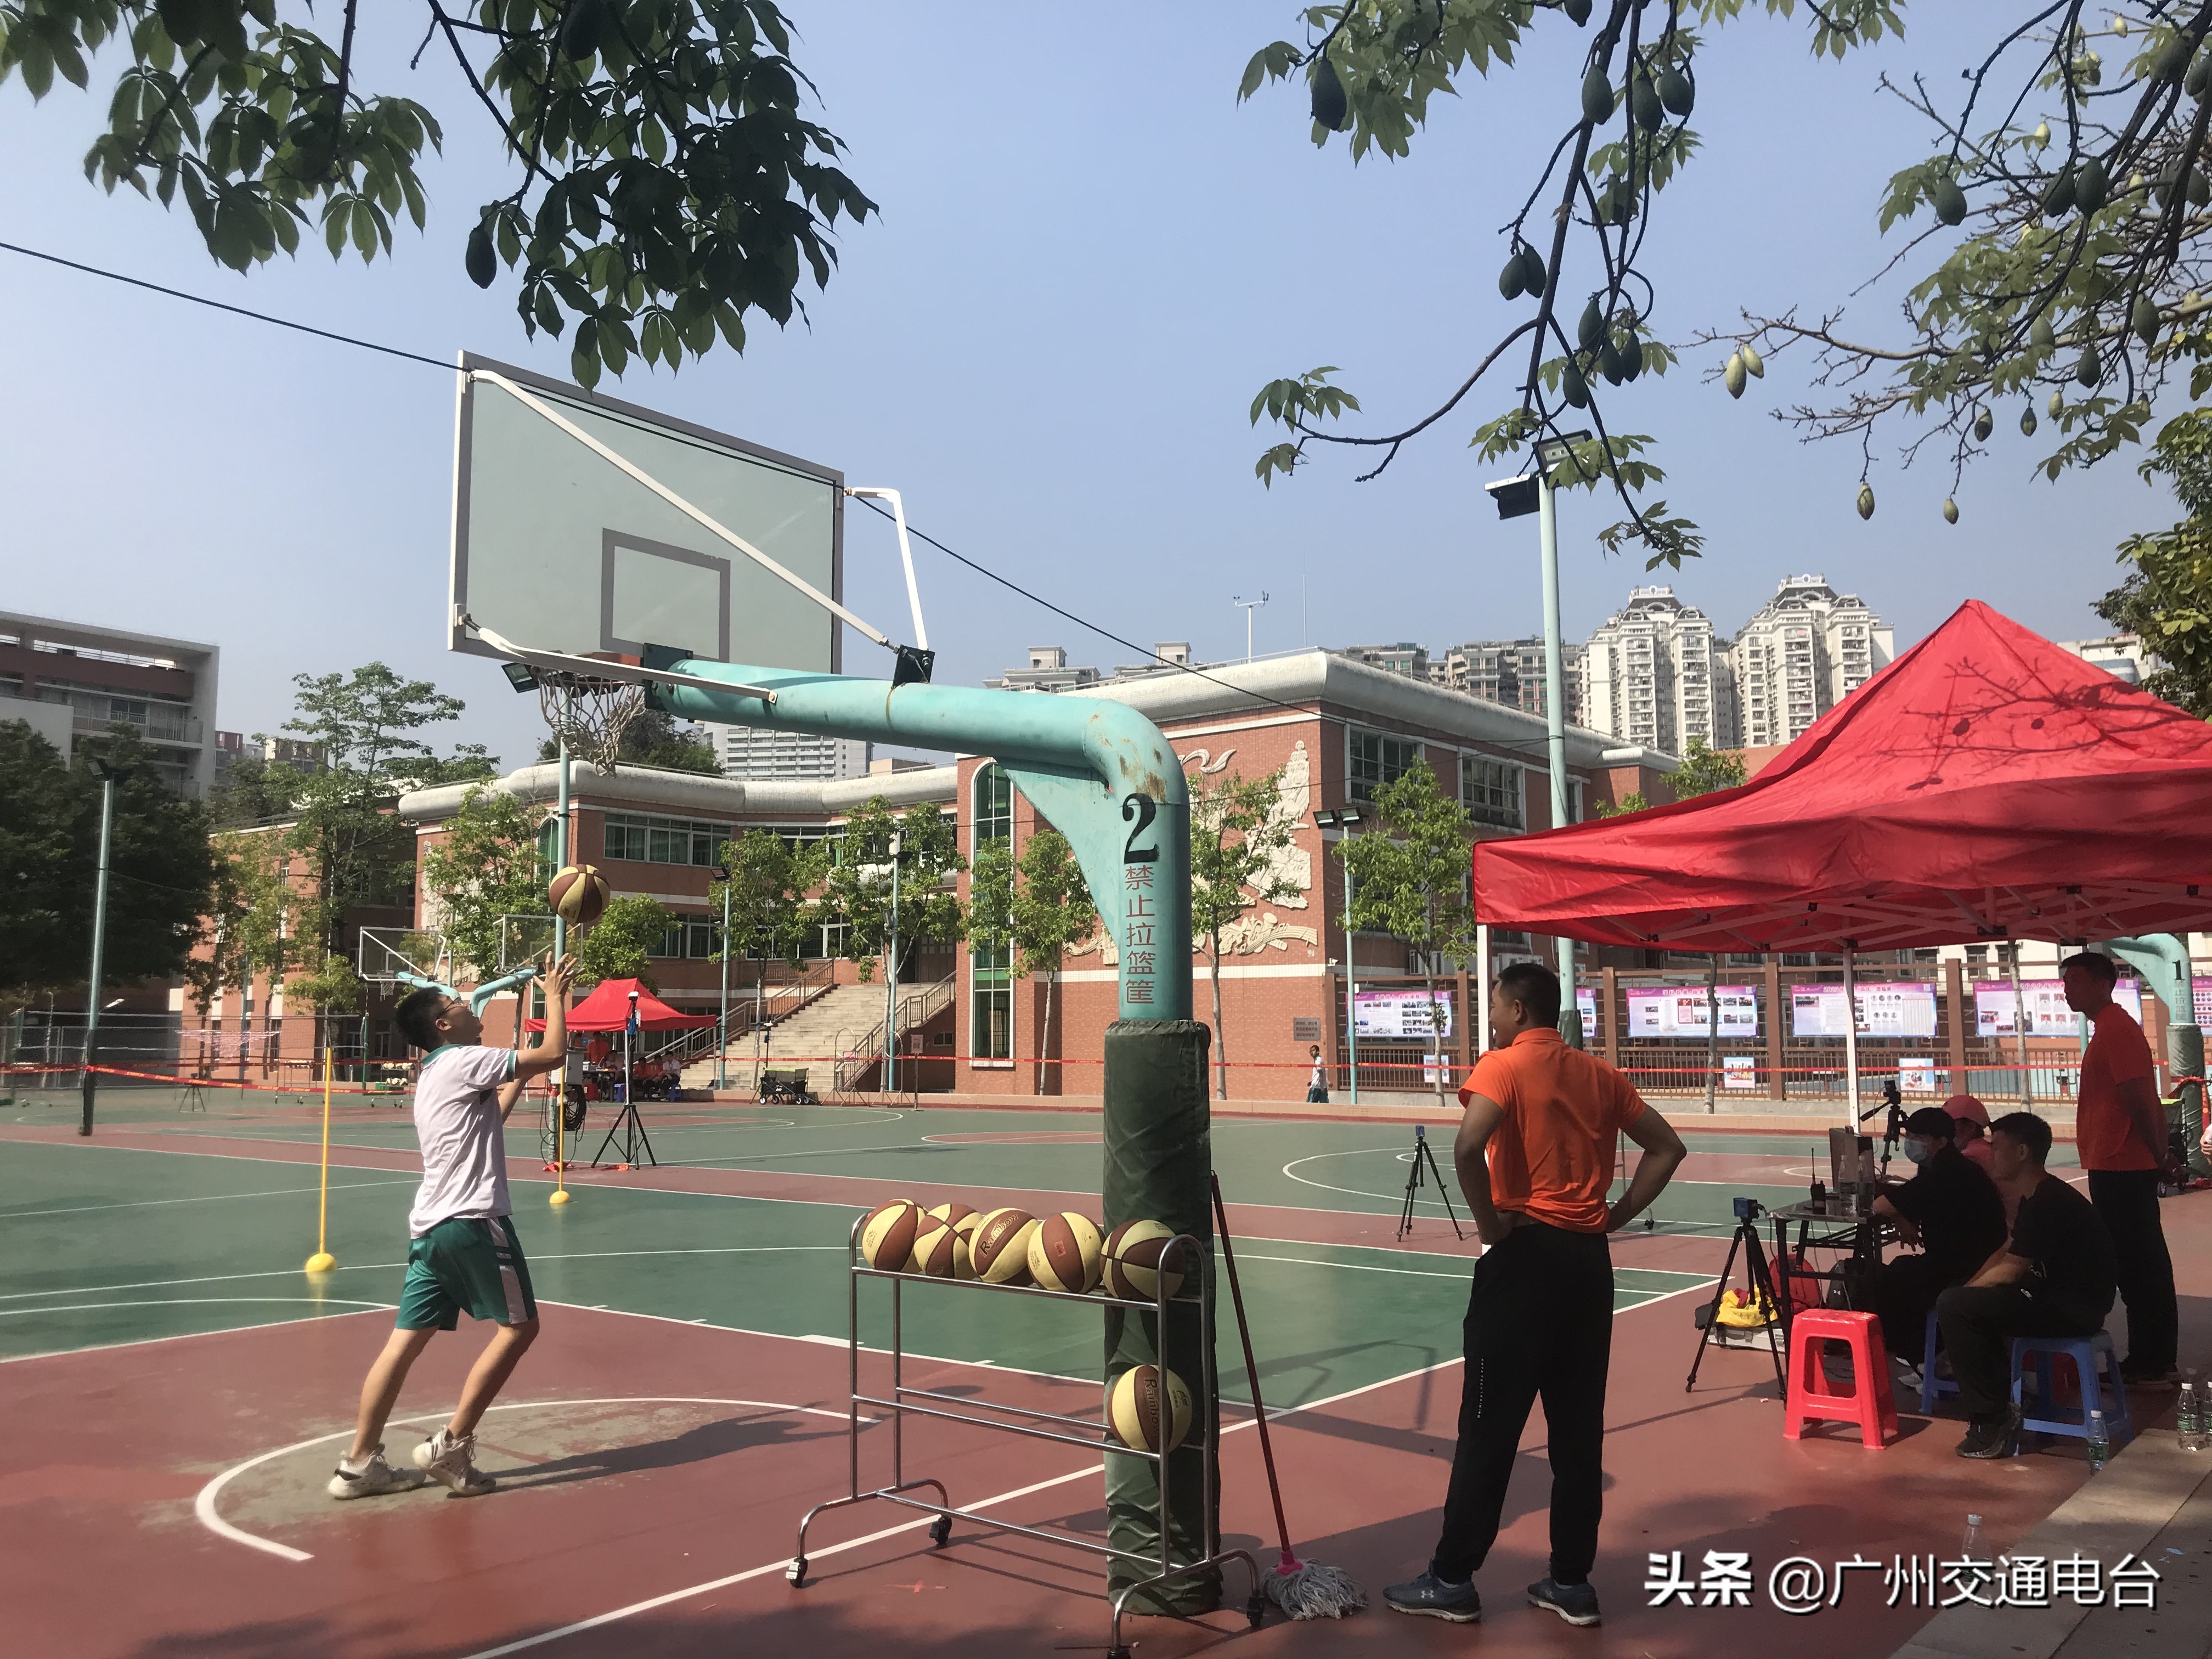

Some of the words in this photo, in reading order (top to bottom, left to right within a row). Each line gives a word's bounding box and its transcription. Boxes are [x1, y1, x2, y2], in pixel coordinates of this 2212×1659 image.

[1122, 793, 1160, 864] 2
[1125, 865, 1156, 1005] 禁止拉篮筐
[2172, 960, 2185, 980] 1
[980, 1214, 1019, 1256] Rainbow
